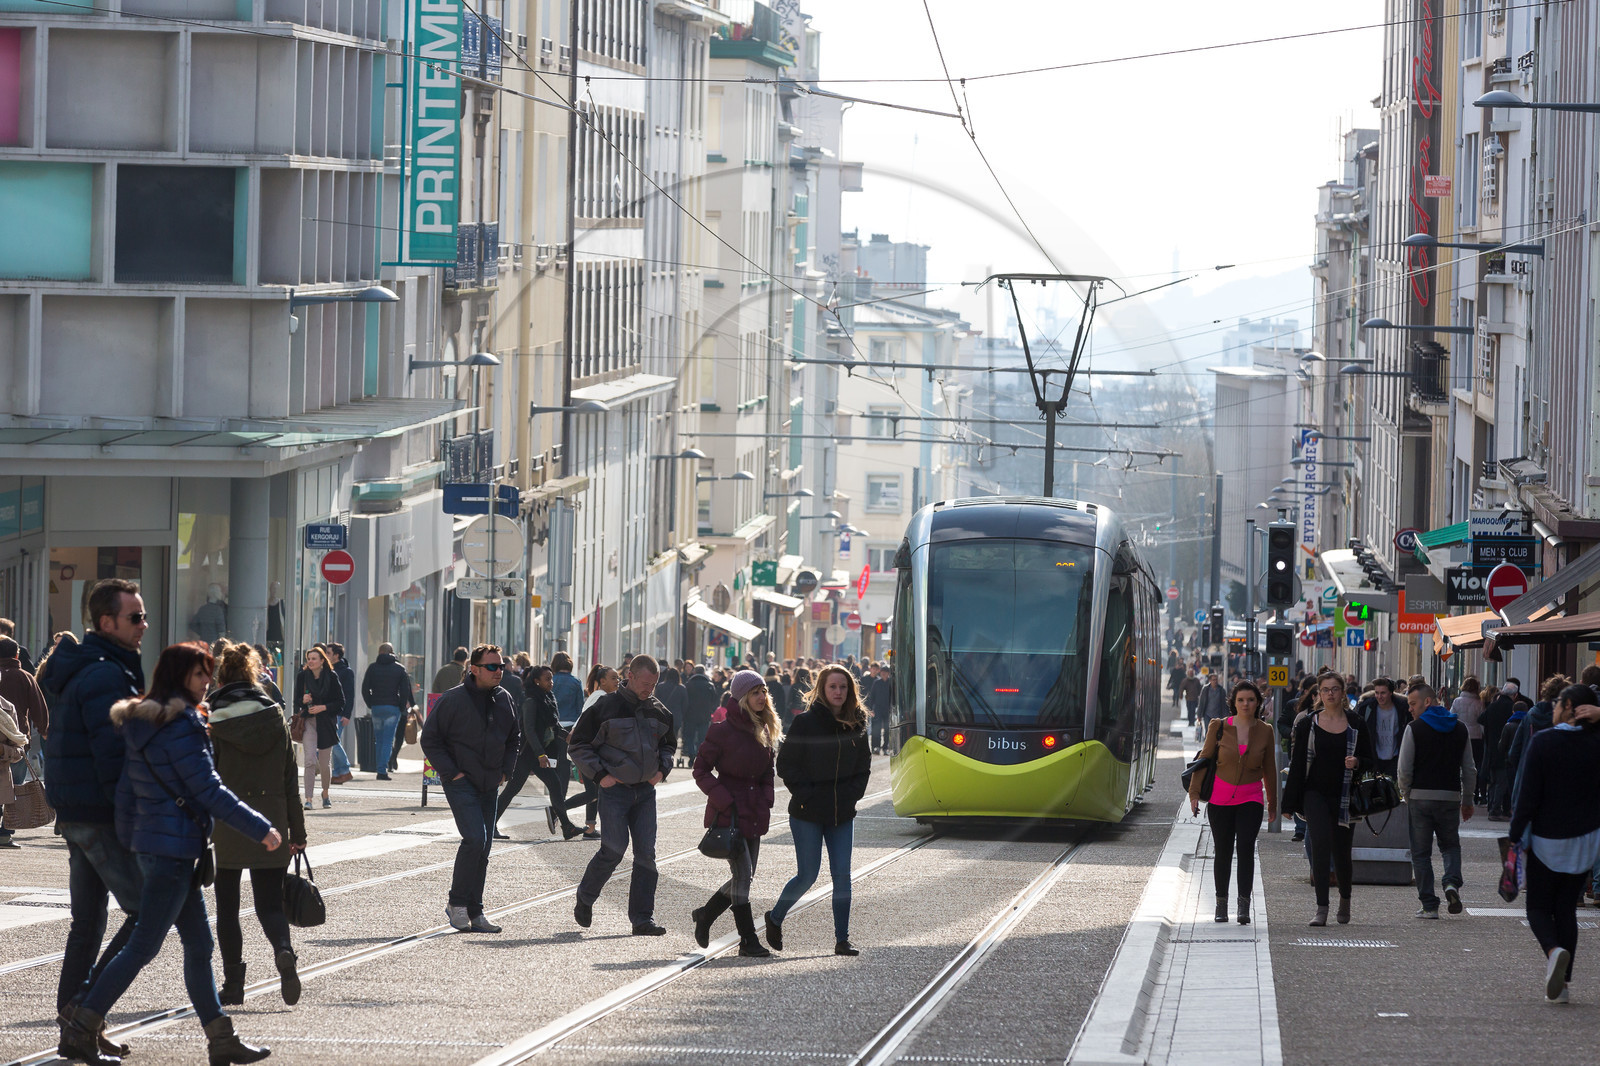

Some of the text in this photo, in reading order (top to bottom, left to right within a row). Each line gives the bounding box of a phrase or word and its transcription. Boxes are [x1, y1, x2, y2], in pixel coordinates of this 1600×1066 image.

[1412, 0, 1443, 119] Guev
[1471, 517, 1520, 526] MAROQUINEIE
[1508, 547, 1528, 557] CLUB
[1457, 592, 1487, 601] lunettie
[1408, 600, 1446, 611] ESPRIT
[1399, 622, 1437, 633] orange
[1270, 670, 1287, 682] 30
[988, 736, 1027, 751] bibus
